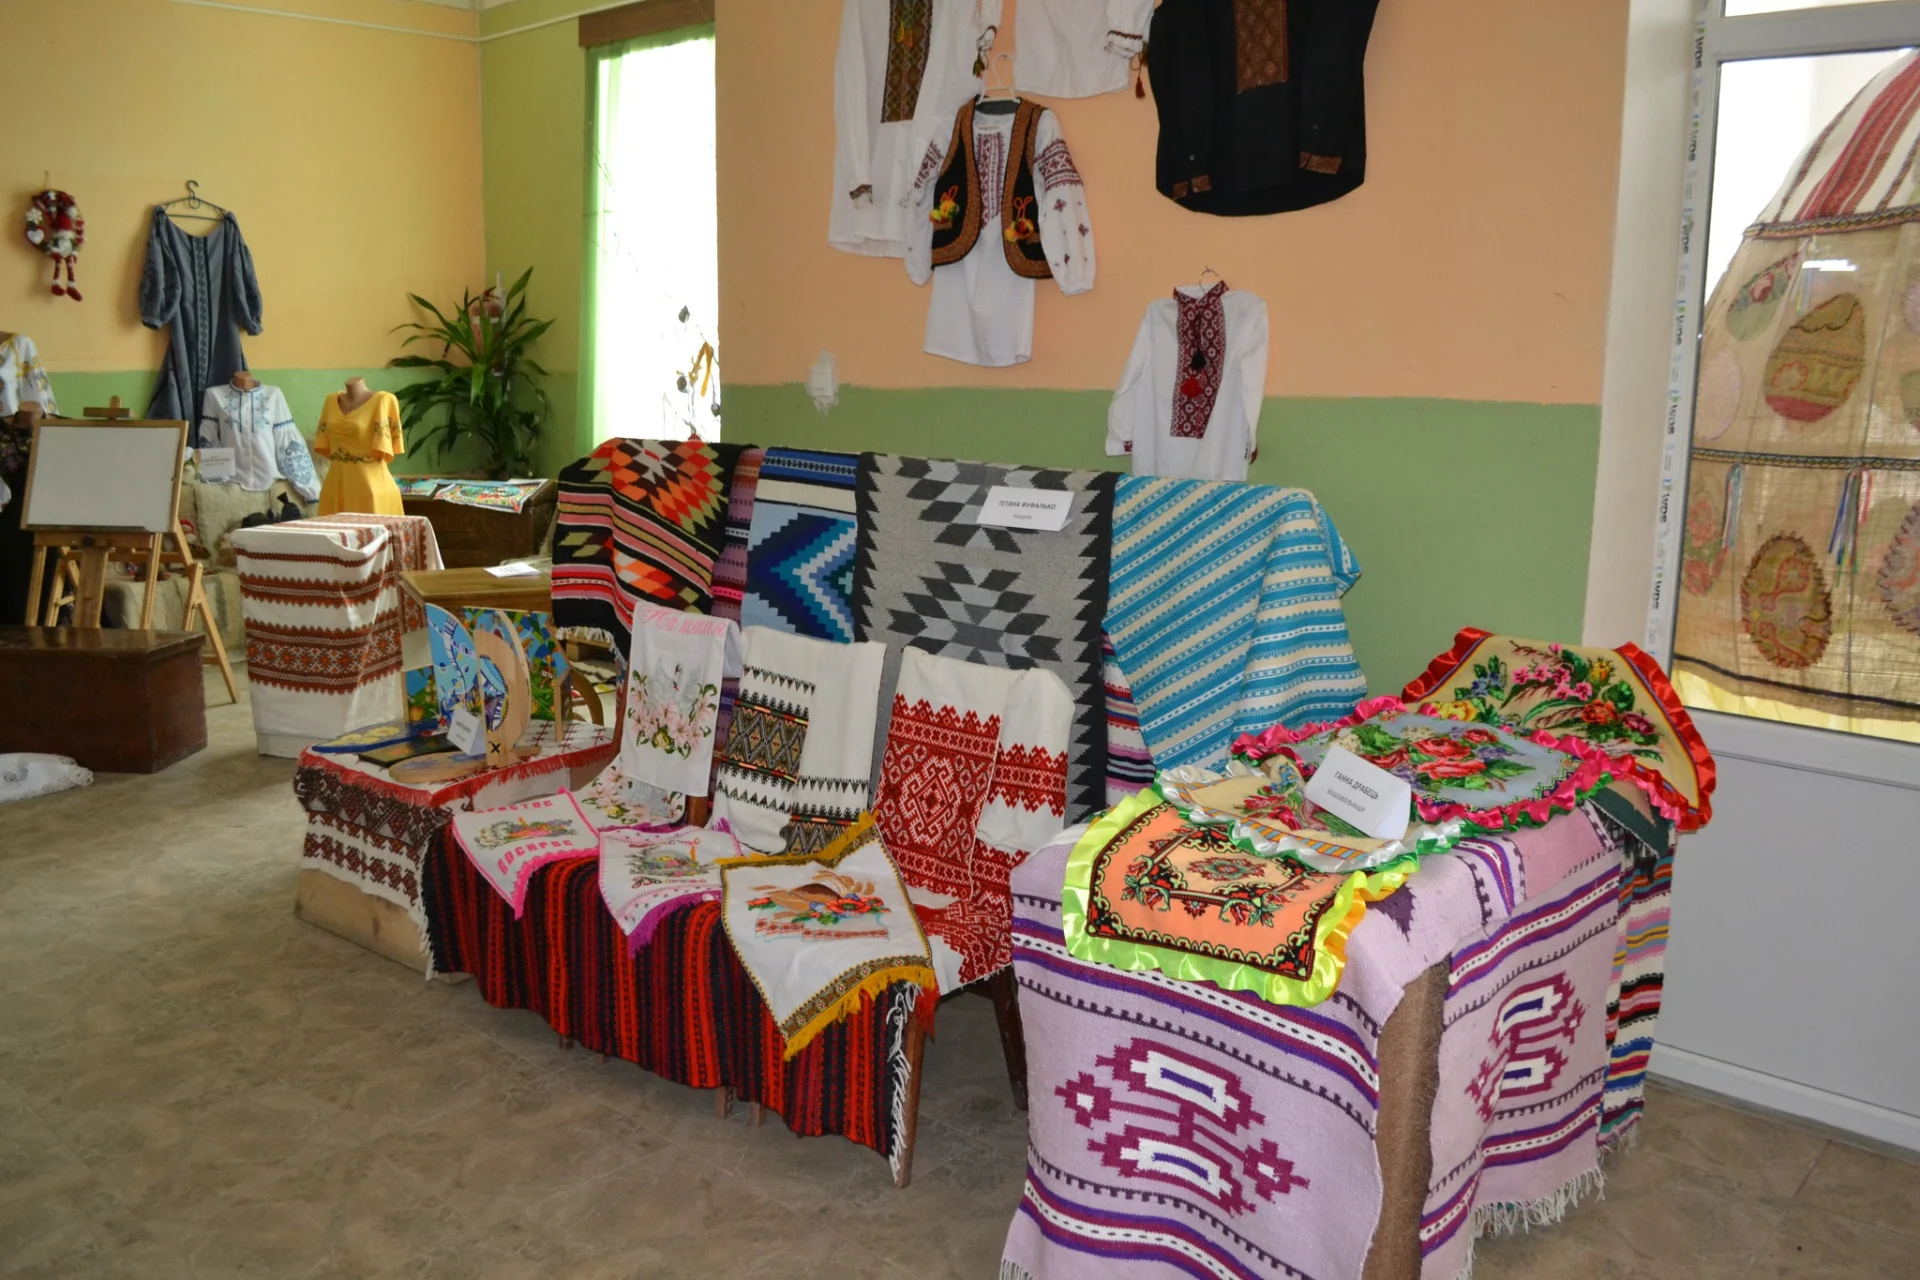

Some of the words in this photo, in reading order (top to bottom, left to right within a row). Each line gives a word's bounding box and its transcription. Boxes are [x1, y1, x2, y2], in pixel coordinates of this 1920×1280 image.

[1694, 36, 1705, 70] WDS
[1021, 502, 1056, 510] ФУФАЛЬКО
[1659, 493, 1670, 524] WDS
[1652, 580, 1662, 610] WDS
[1334, 771, 1354, 786] ГАННА
[1351, 781, 1379, 800] ДРАБЕЦЬ
